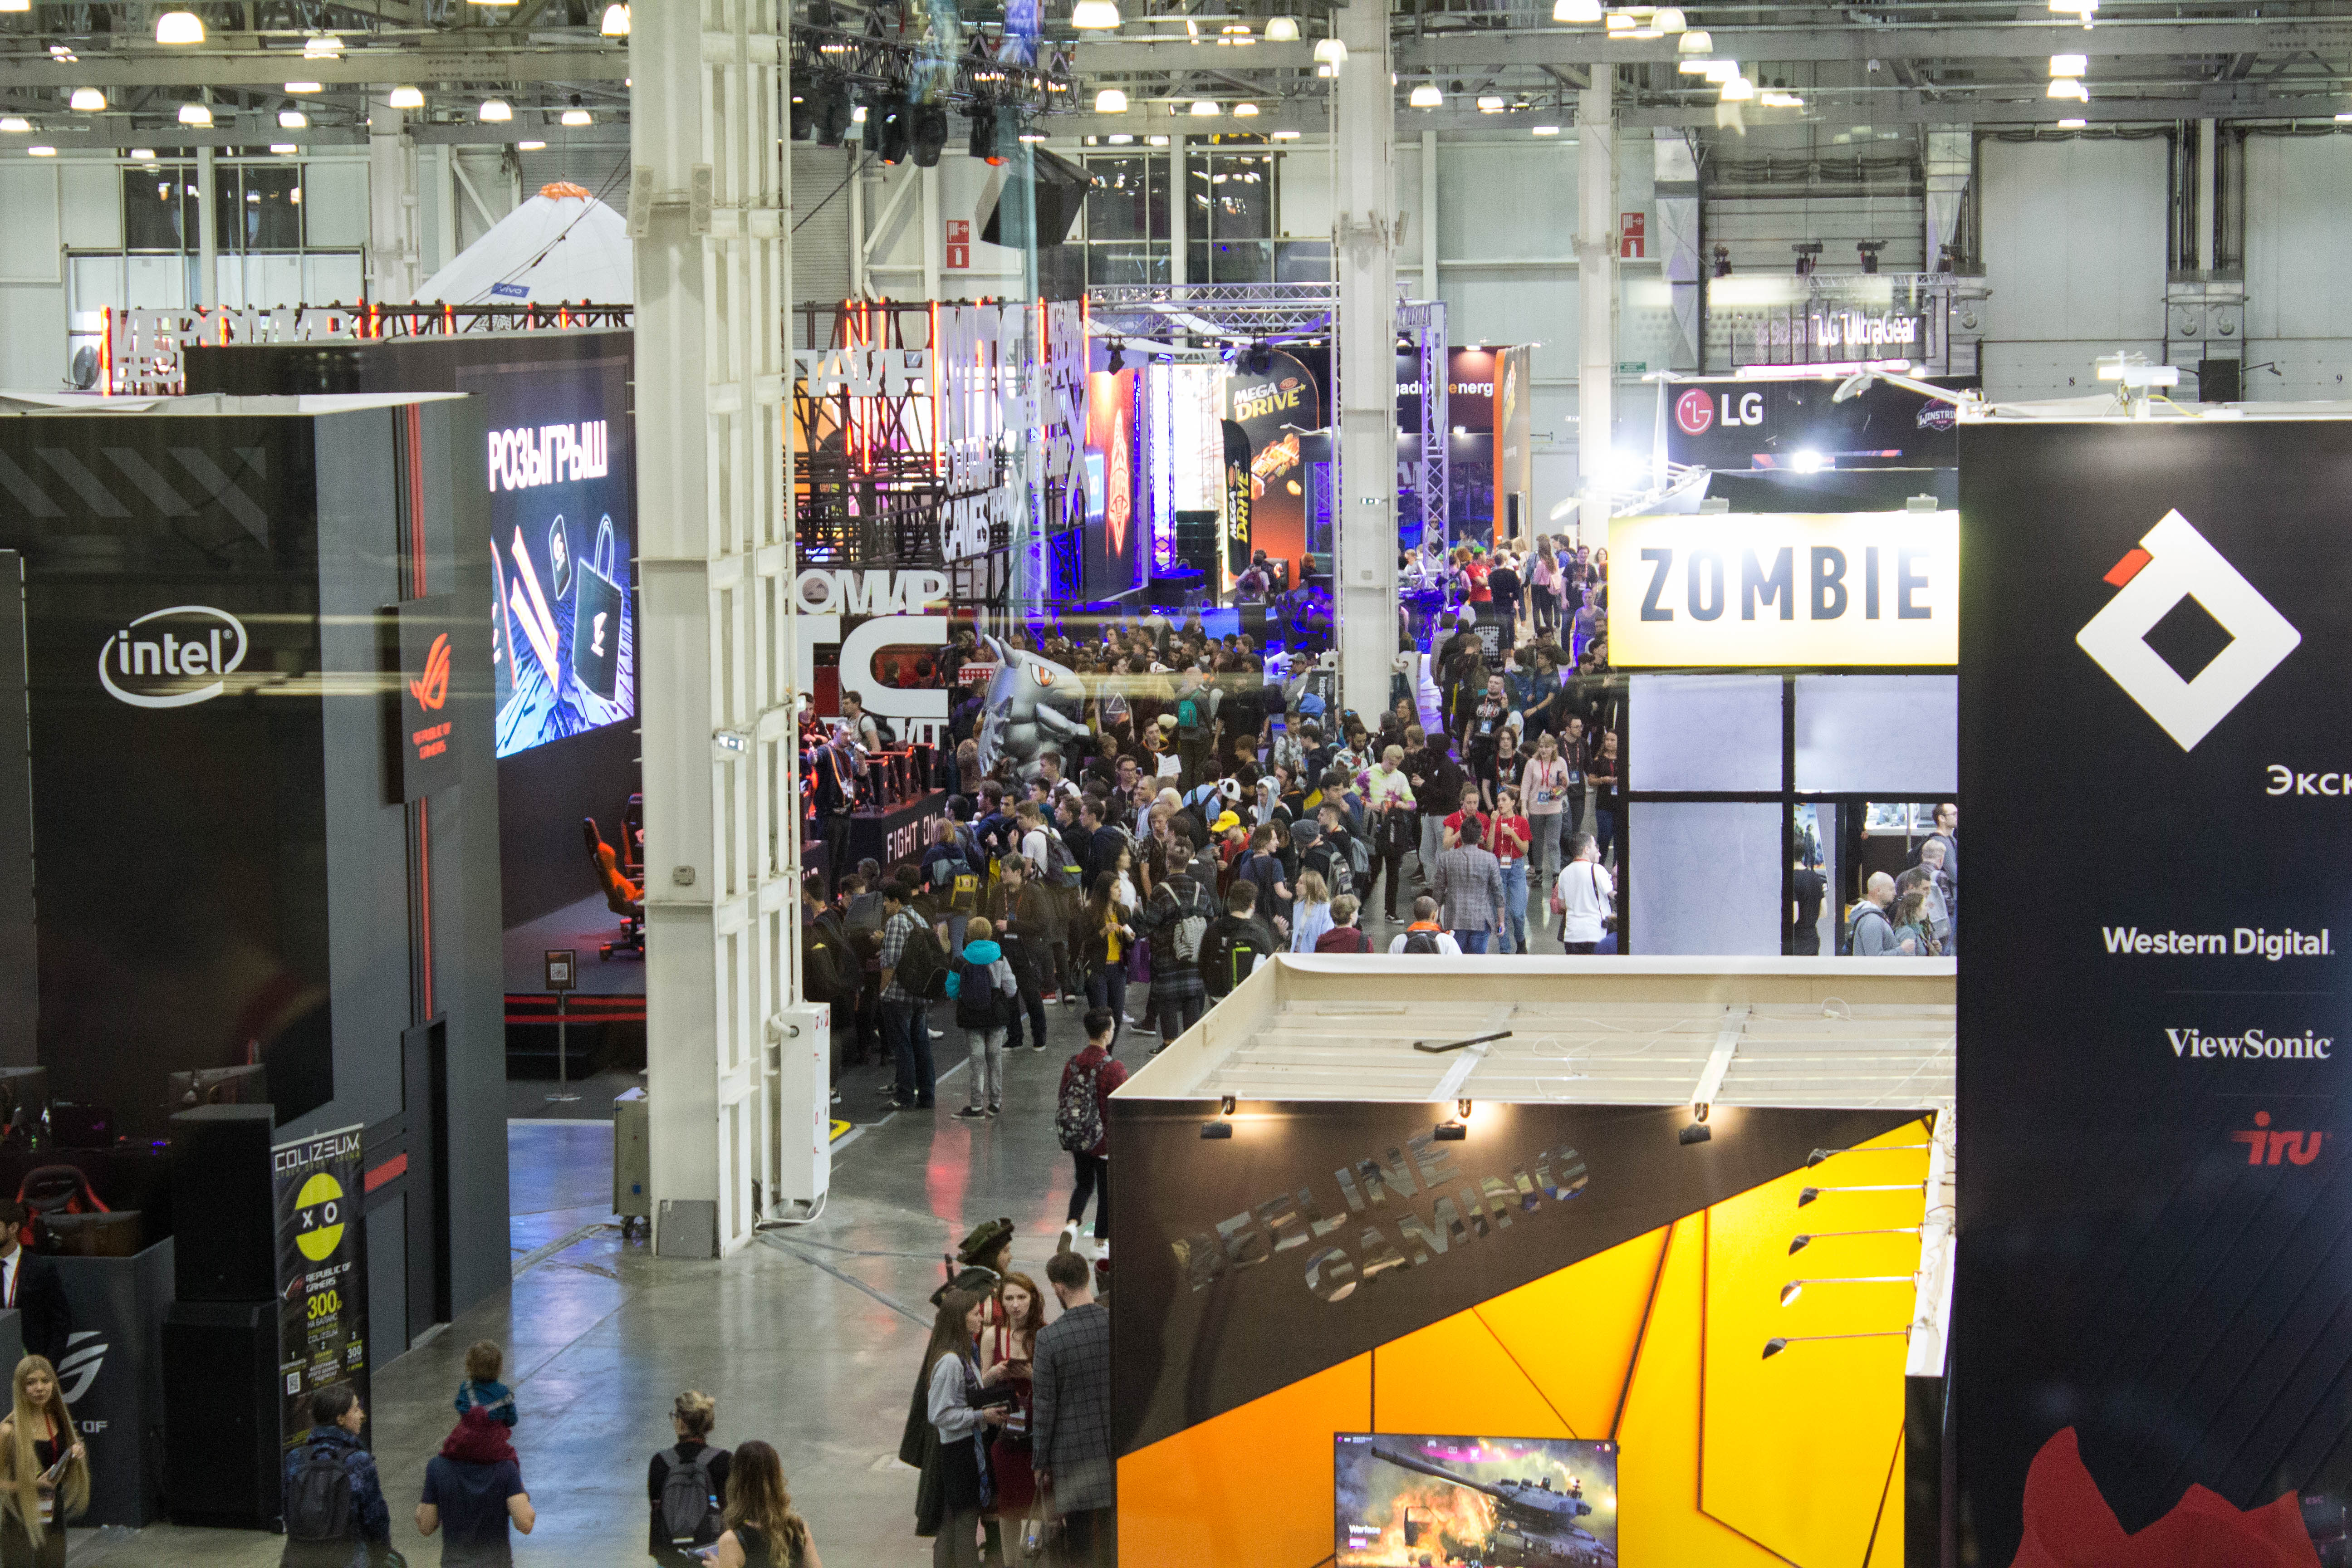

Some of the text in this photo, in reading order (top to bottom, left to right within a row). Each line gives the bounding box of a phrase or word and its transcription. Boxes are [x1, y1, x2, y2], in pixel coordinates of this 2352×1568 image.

[499, 285, 522, 294] vivo
[1818, 311, 1840, 345] LG
[1842, 310, 1918, 345] UltraGear
[1233, 382, 1278, 405] MEGA
[1449, 382, 1494, 397] energ
[2069, 377, 2075, 386] 8
[2337, 373, 2342, 384] 9
[1234, 389, 1300, 422] DRIVE
[1721, 392, 1764, 426] LG
[1919, 410, 1957, 426] WINSTRI
[488, 419, 608, 493] РОЗЫГРЫШ
[1229, 490, 1237, 539] MEGA
[1236, 468, 1249, 544] DRIVE
[940, 493, 990, 563] GAMES
[795, 568, 949, 615] ОМИР
[1640, 545, 1932, 622] ZOMBIE
[118, 628, 221, 676] intel
[796, 614, 949, 718] ТС
[887, 820, 918, 863] FIGHT
[2102, 926, 2330, 961] Western Digital
[2165, 1028, 2332, 1059] ViewSonic
[275, 1132, 359, 1171] COLIZEUM
[1304, 1145, 1588, 1303] GAMING
[82, 1420, 108, 1433] OF
[1348, 1524, 1381, 1534] Warface
